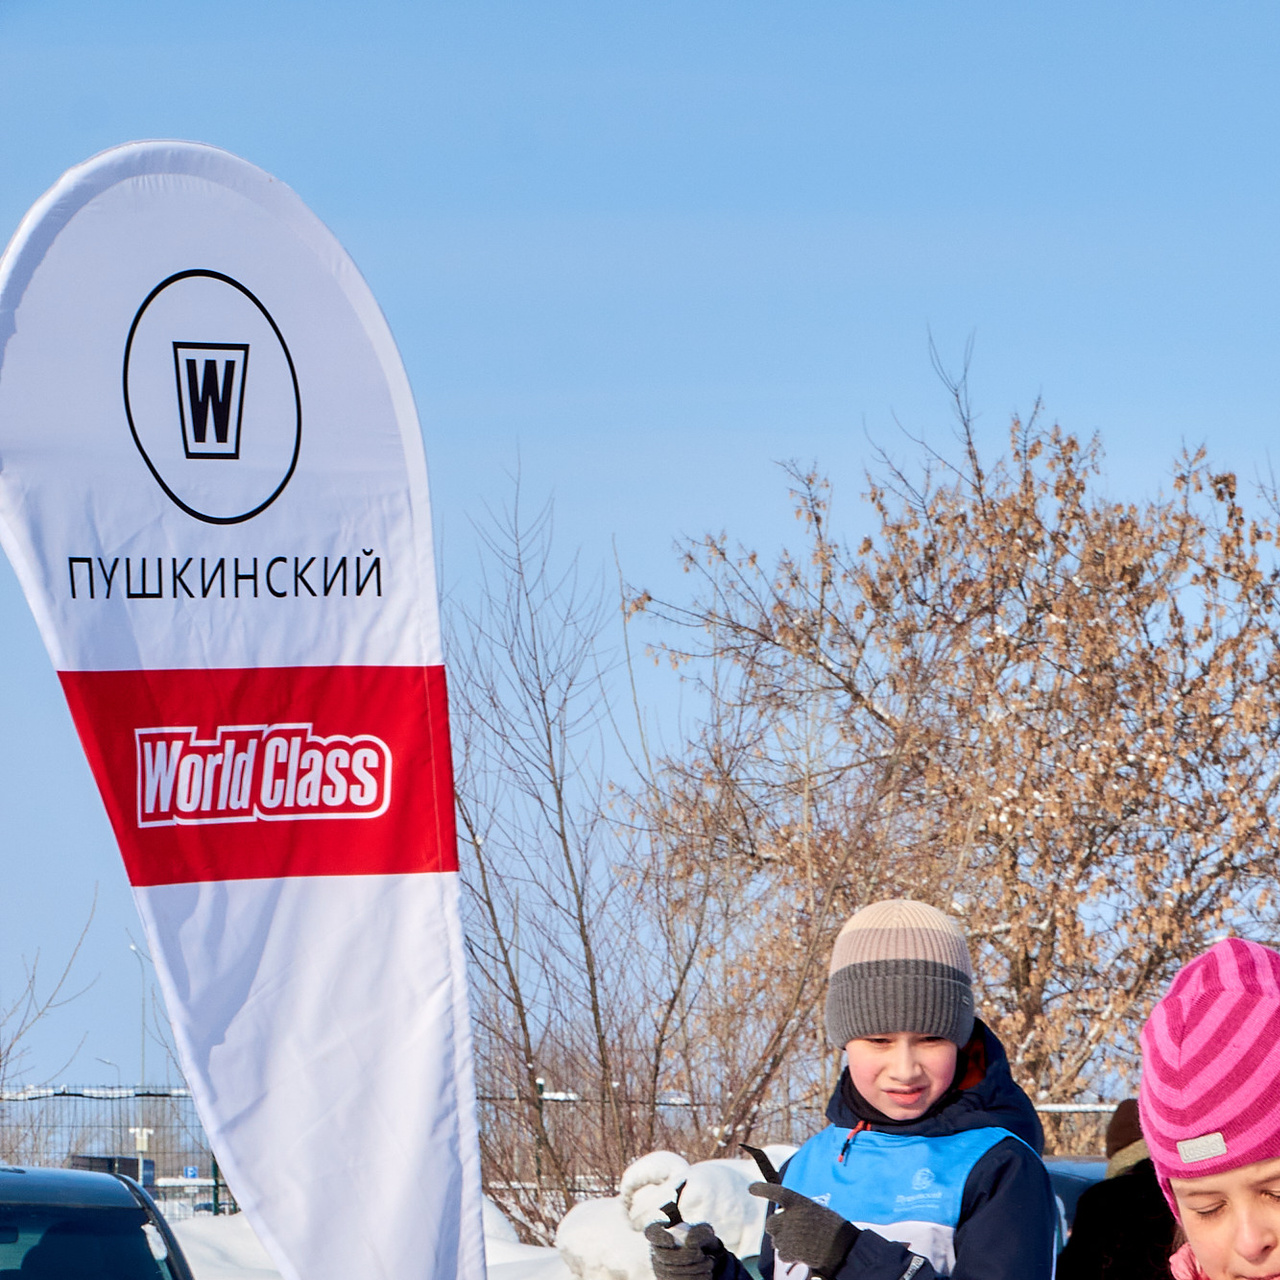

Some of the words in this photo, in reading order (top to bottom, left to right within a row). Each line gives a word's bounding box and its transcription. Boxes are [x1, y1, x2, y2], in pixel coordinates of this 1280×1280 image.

[186, 359, 235, 443] W
[68, 549, 382, 598] ПУШКИНСКИЙ
[143, 736, 258, 815] World
[261, 735, 378, 807] Class
